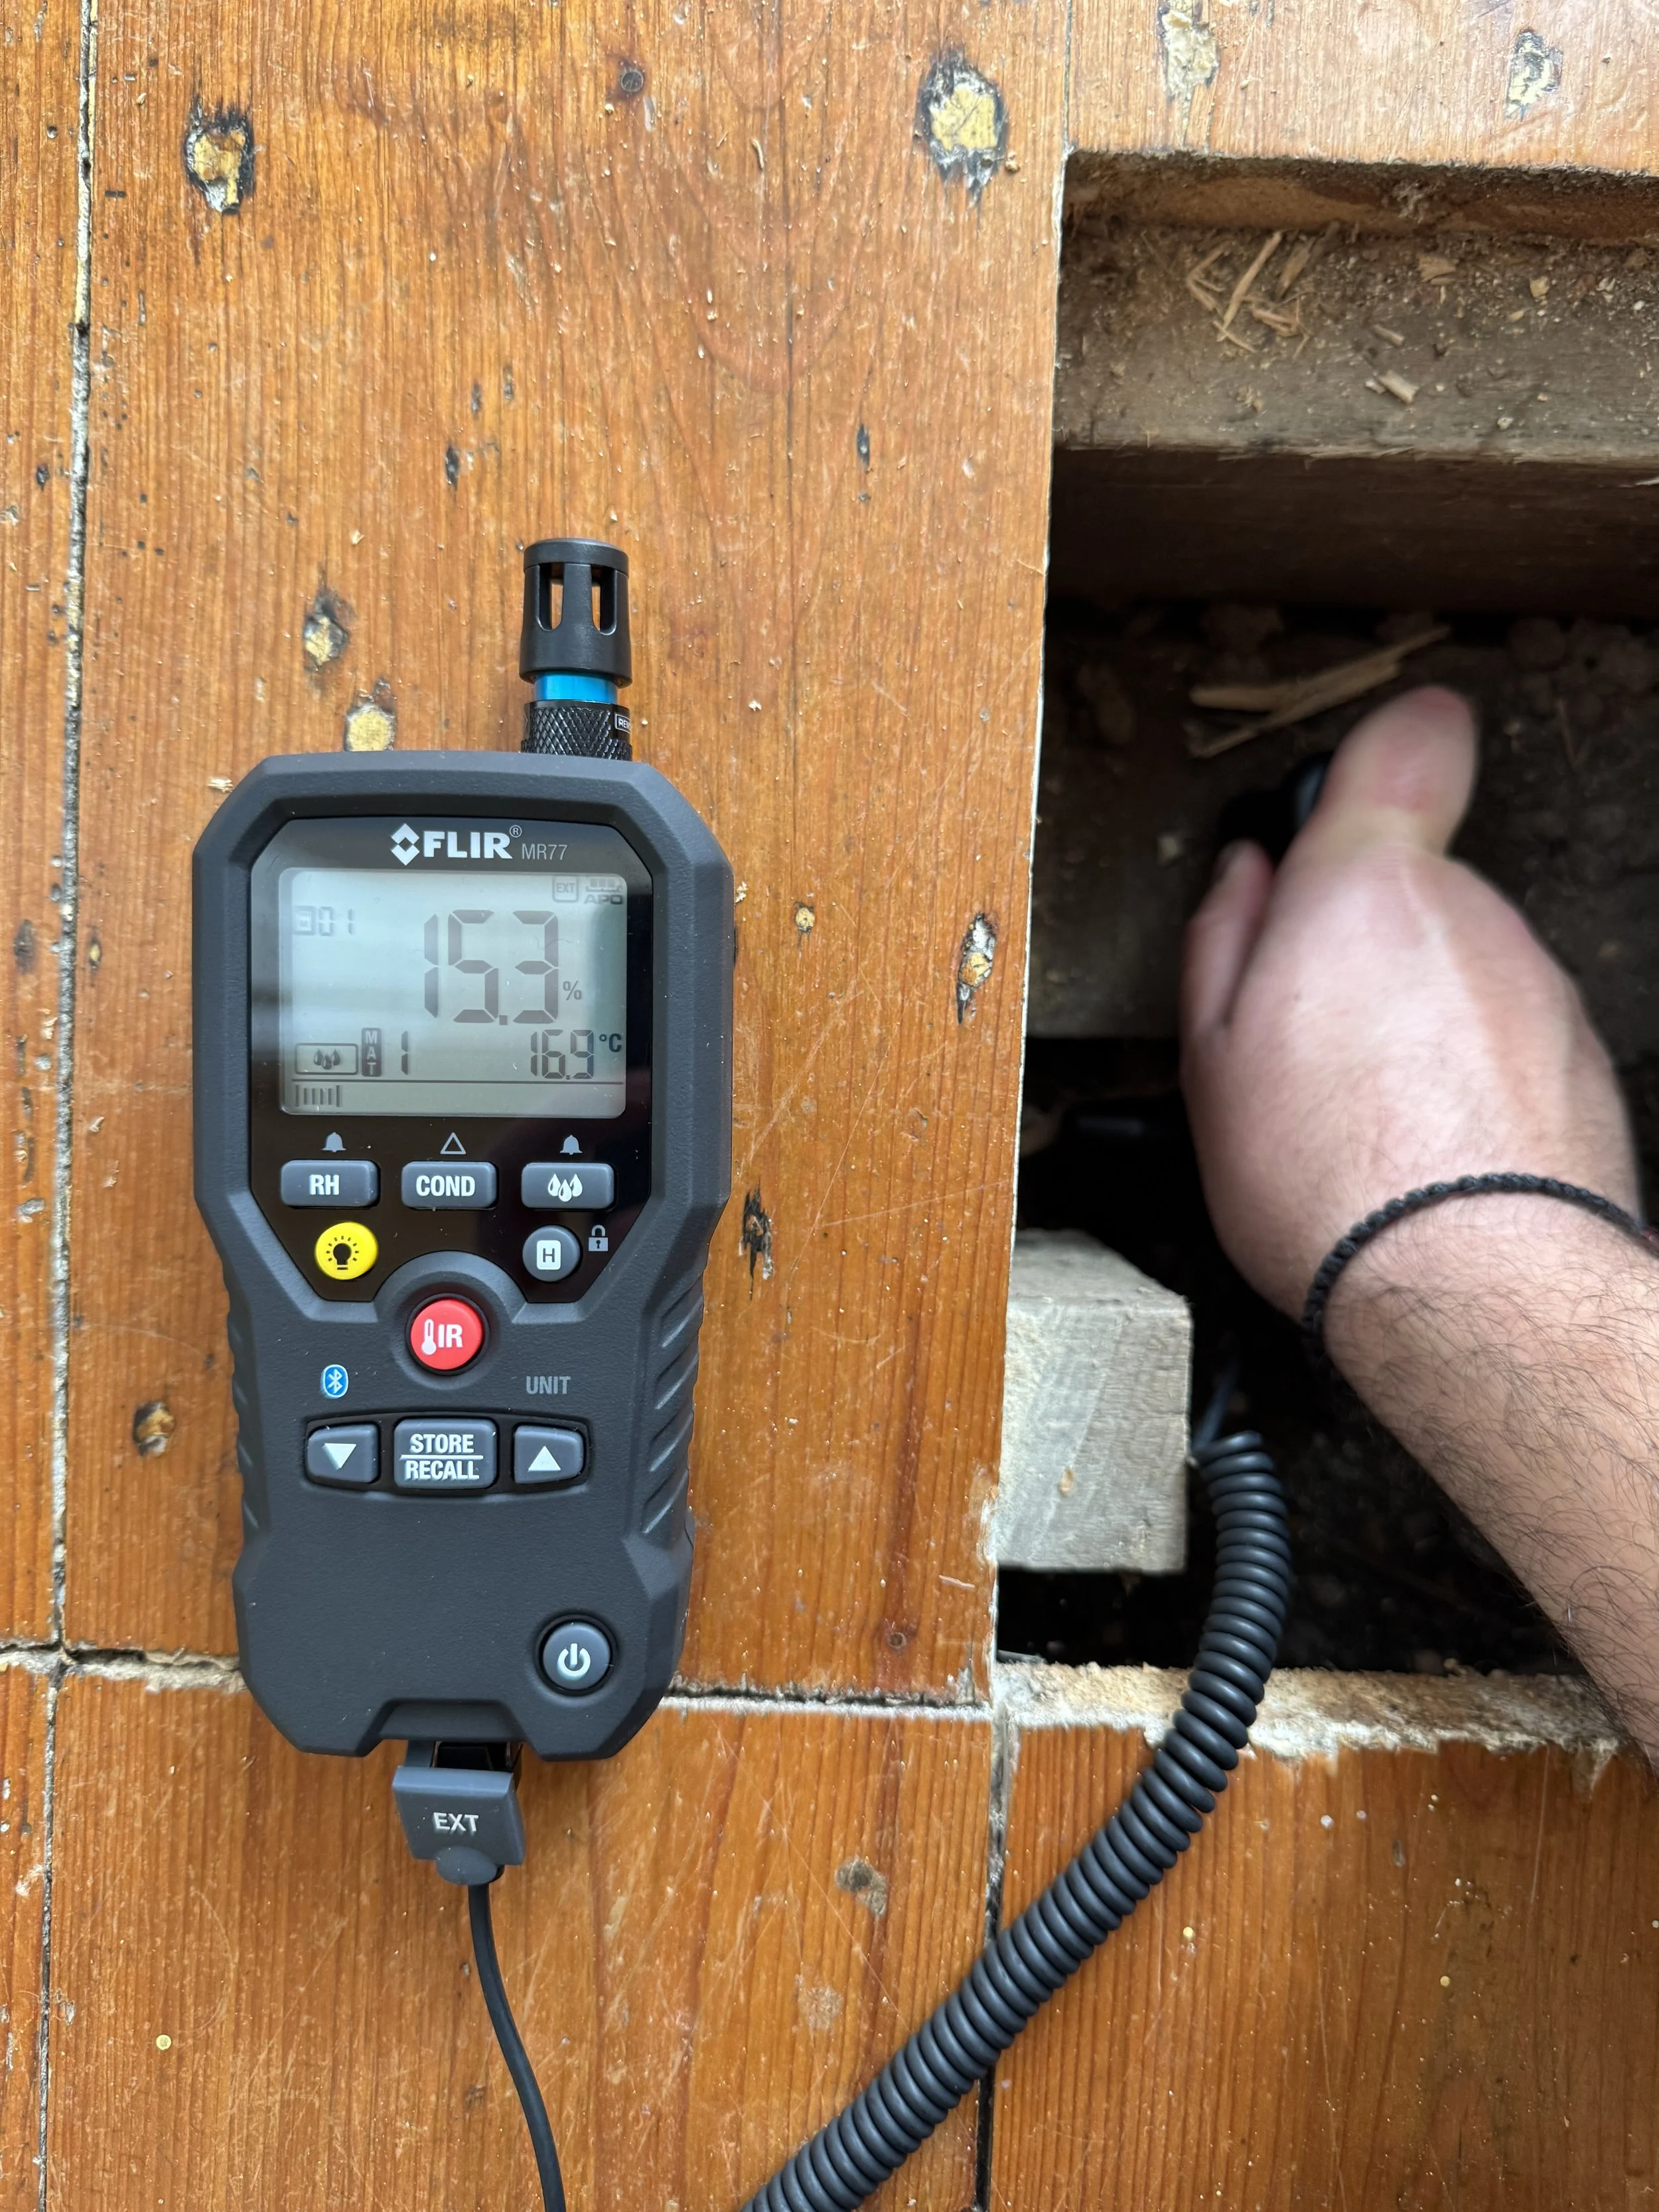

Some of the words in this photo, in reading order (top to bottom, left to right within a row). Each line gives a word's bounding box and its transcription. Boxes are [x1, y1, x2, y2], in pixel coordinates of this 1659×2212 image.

[522, 844, 568, 860] MR77
[556, 882, 575, 893] EXT
[585, 894, 623, 905] APO
[424, 909, 559, 1025] 15.3
[563, 981, 582, 1000] %
[531, 1029, 594, 1080] 16.9
[599, 1033, 622, 1053] °C
[309, 1174, 340, 1195] RH
[416, 1175, 476, 1197] COND
[543, 1248, 555, 1262] H
[438, 1323, 463, 1348] IR
[526, 1376, 571, 1394] UNIT
[411, 1434, 474, 1453] STORE
[405, 1460, 480, 1480] RECALL
[433, 1812, 479, 1832] EXT
